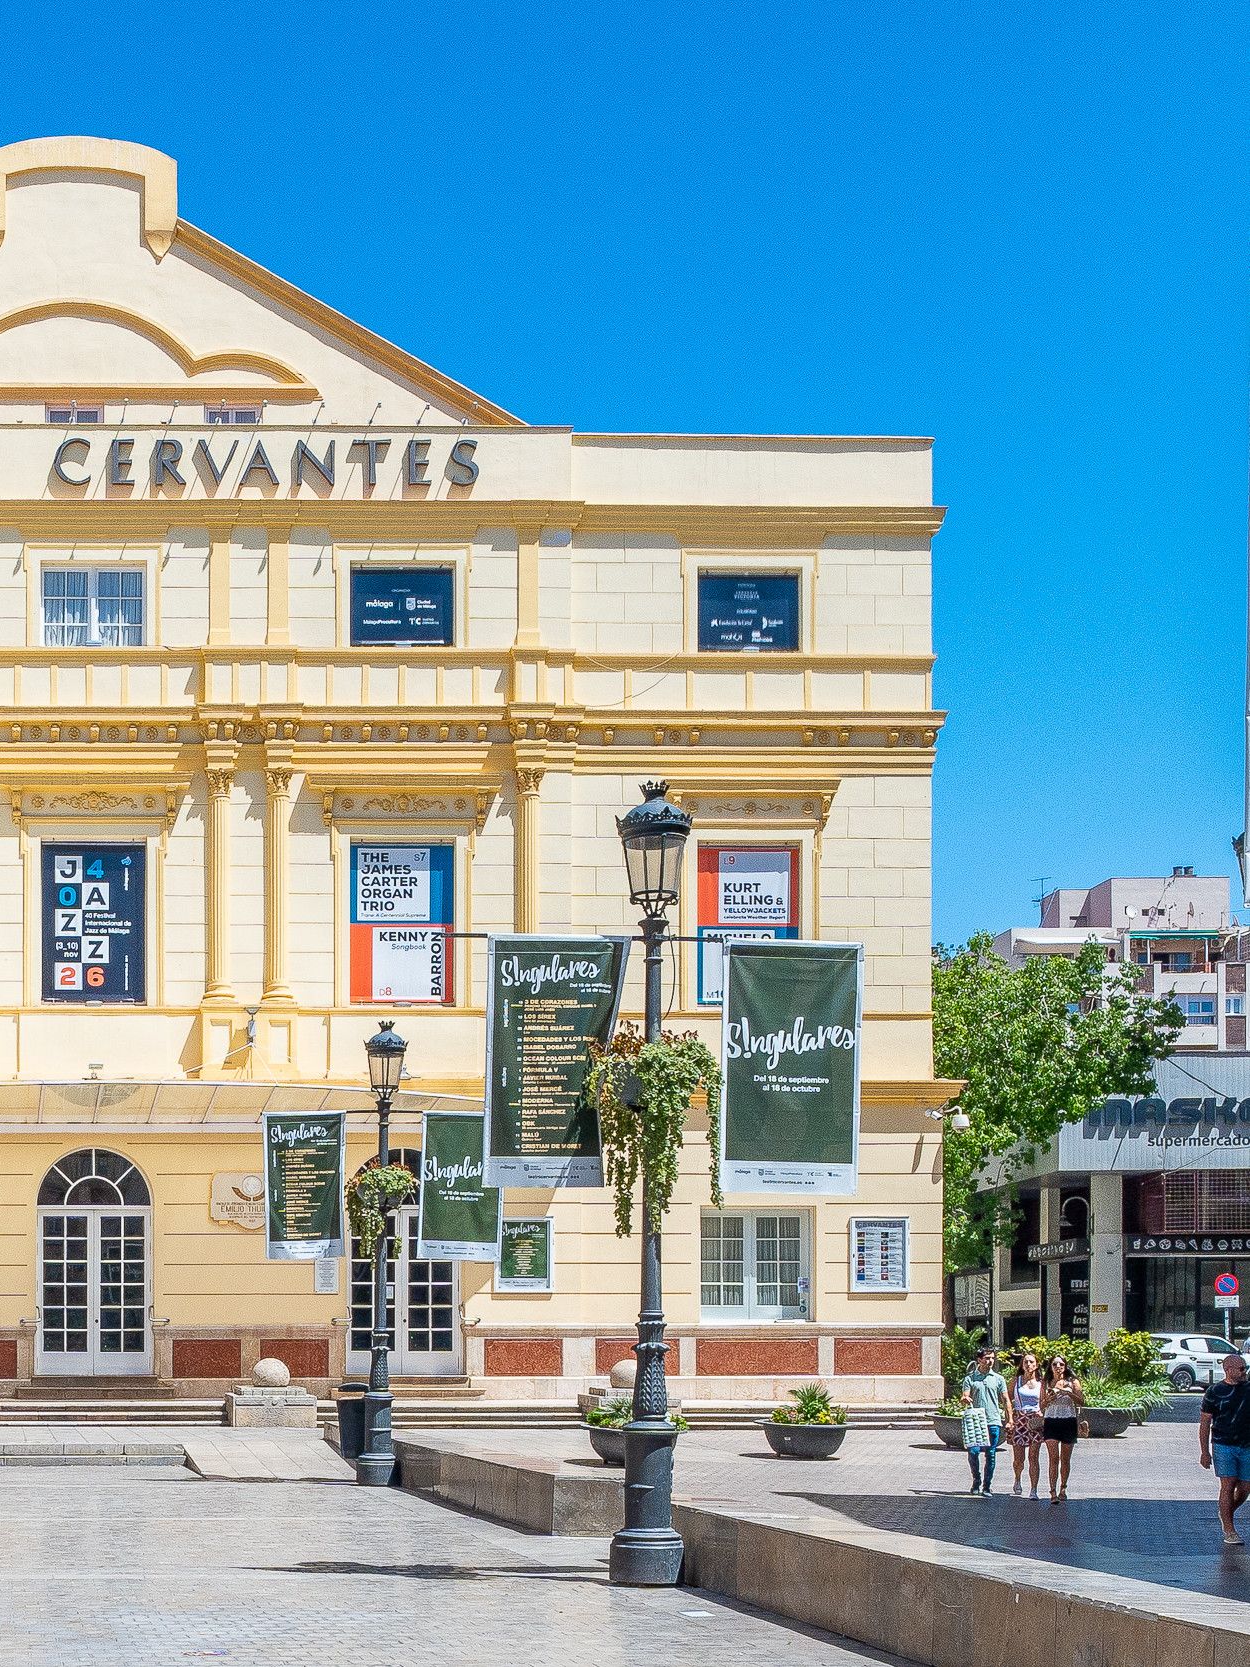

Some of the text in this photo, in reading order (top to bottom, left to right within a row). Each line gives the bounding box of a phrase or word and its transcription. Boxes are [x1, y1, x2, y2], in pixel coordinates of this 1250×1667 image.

[54, 438, 480, 487] CERVANTES
[361, 852, 389, 863] THE
[60, 860, 104, 878] J 4
[361, 864, 412, 875] JAMES
[361, 876, 418, 887] CARTER
[724, 882, 761, 893] KURT
[86, 887, 106, 906] A
[361, 888, 413, 899] ORGAN
[361, 900, 395, 911] TRIO
[724, 895, 784, 906] ELLING &
[61, 913, 77, 932] Z
[379, 931, 428, 942] KENNY
[88, 940, 104, 959] Z
[392, 943, 426, 951] Songbook
[431, 932, 442, 996] BARRON
[61, 967, 76, 985] 2
[86, 966, 105, 987] 6
[379, 986, 392, 996] D8
[778, 1075, 787, 1083] de
[788, 1076, 829, 1085] septiembre
[781, 1084, 791, 1092] de
[791, 1085, 821, 1093] octubre
[220, 1205, 245, 1213] EMILIO
